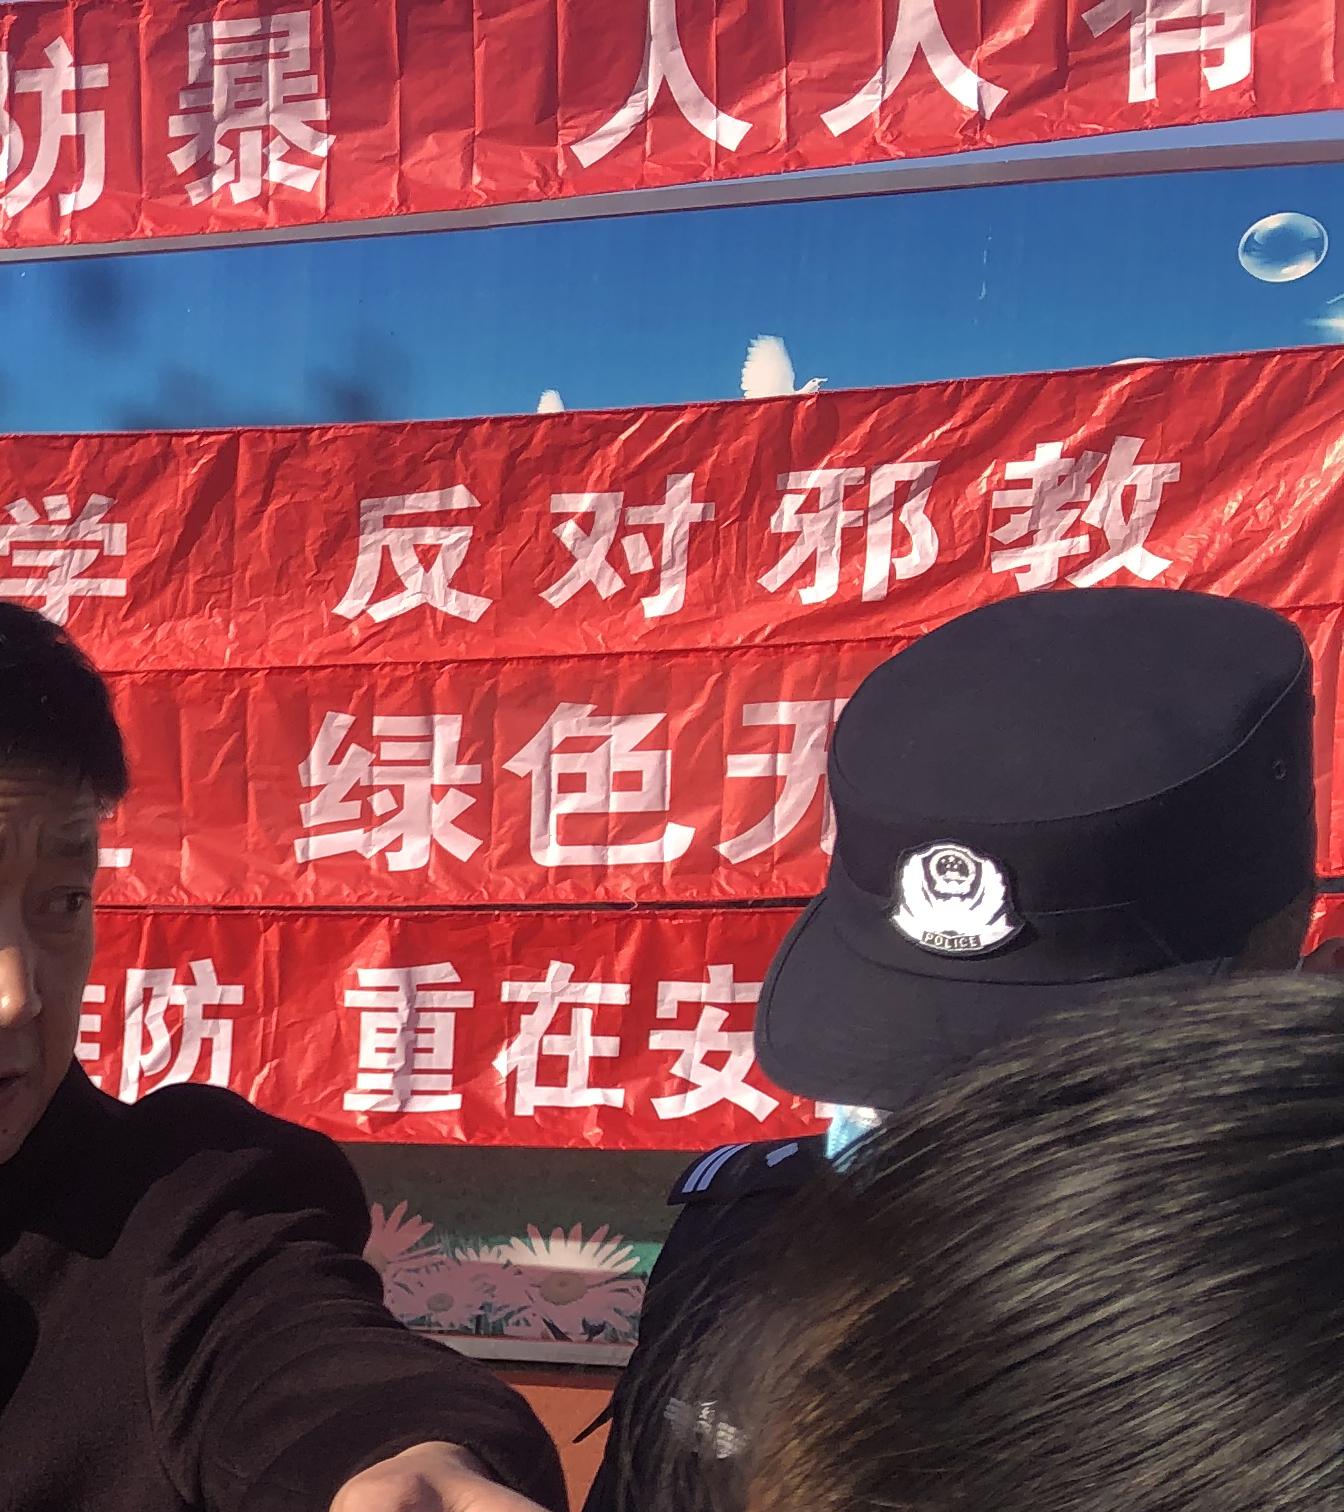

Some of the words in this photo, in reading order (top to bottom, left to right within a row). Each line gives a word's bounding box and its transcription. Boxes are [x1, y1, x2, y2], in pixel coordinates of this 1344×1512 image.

[332, 435, 1181, 623] 反对邪教
[923, 933, 979, 949] POLICE
